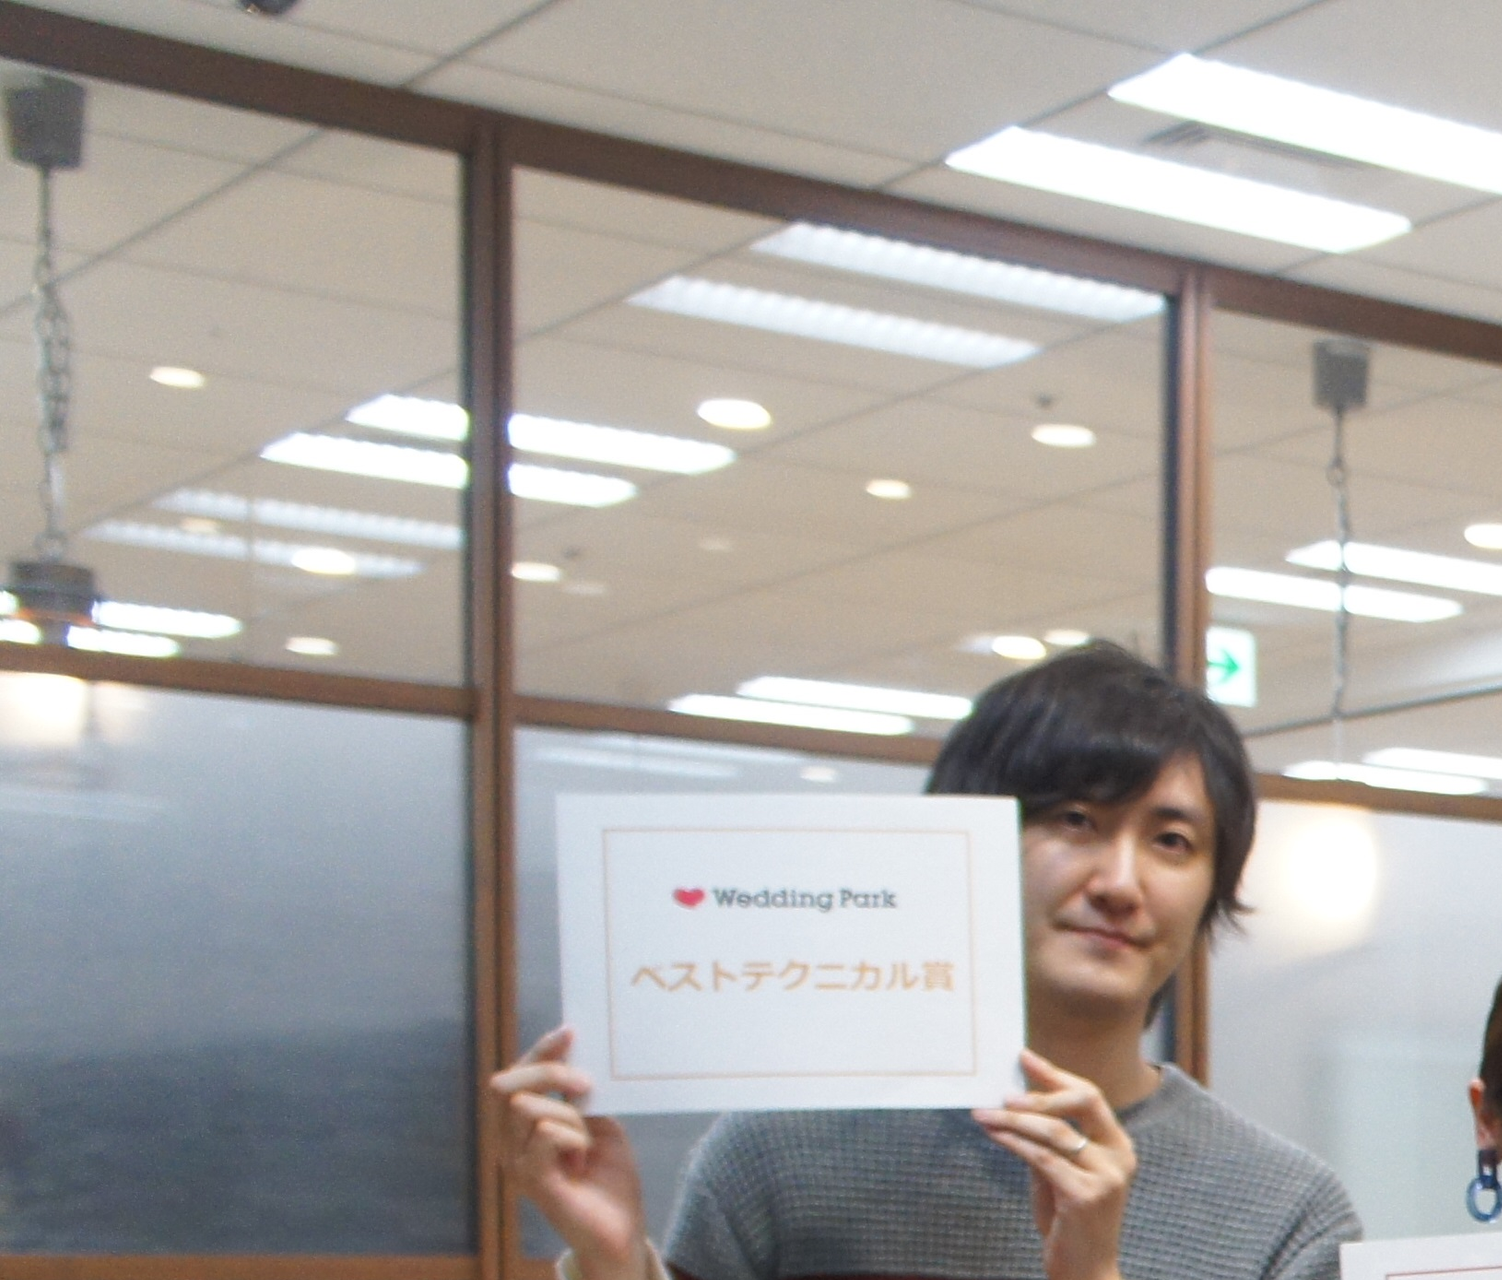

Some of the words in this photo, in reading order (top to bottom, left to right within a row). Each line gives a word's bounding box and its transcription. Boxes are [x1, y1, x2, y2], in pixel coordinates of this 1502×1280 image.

[711, 887, 834, 911] Wedding
[839, 888, 898, 909] Park
[631, 960, 955, 993] ベストテクニカル賞
